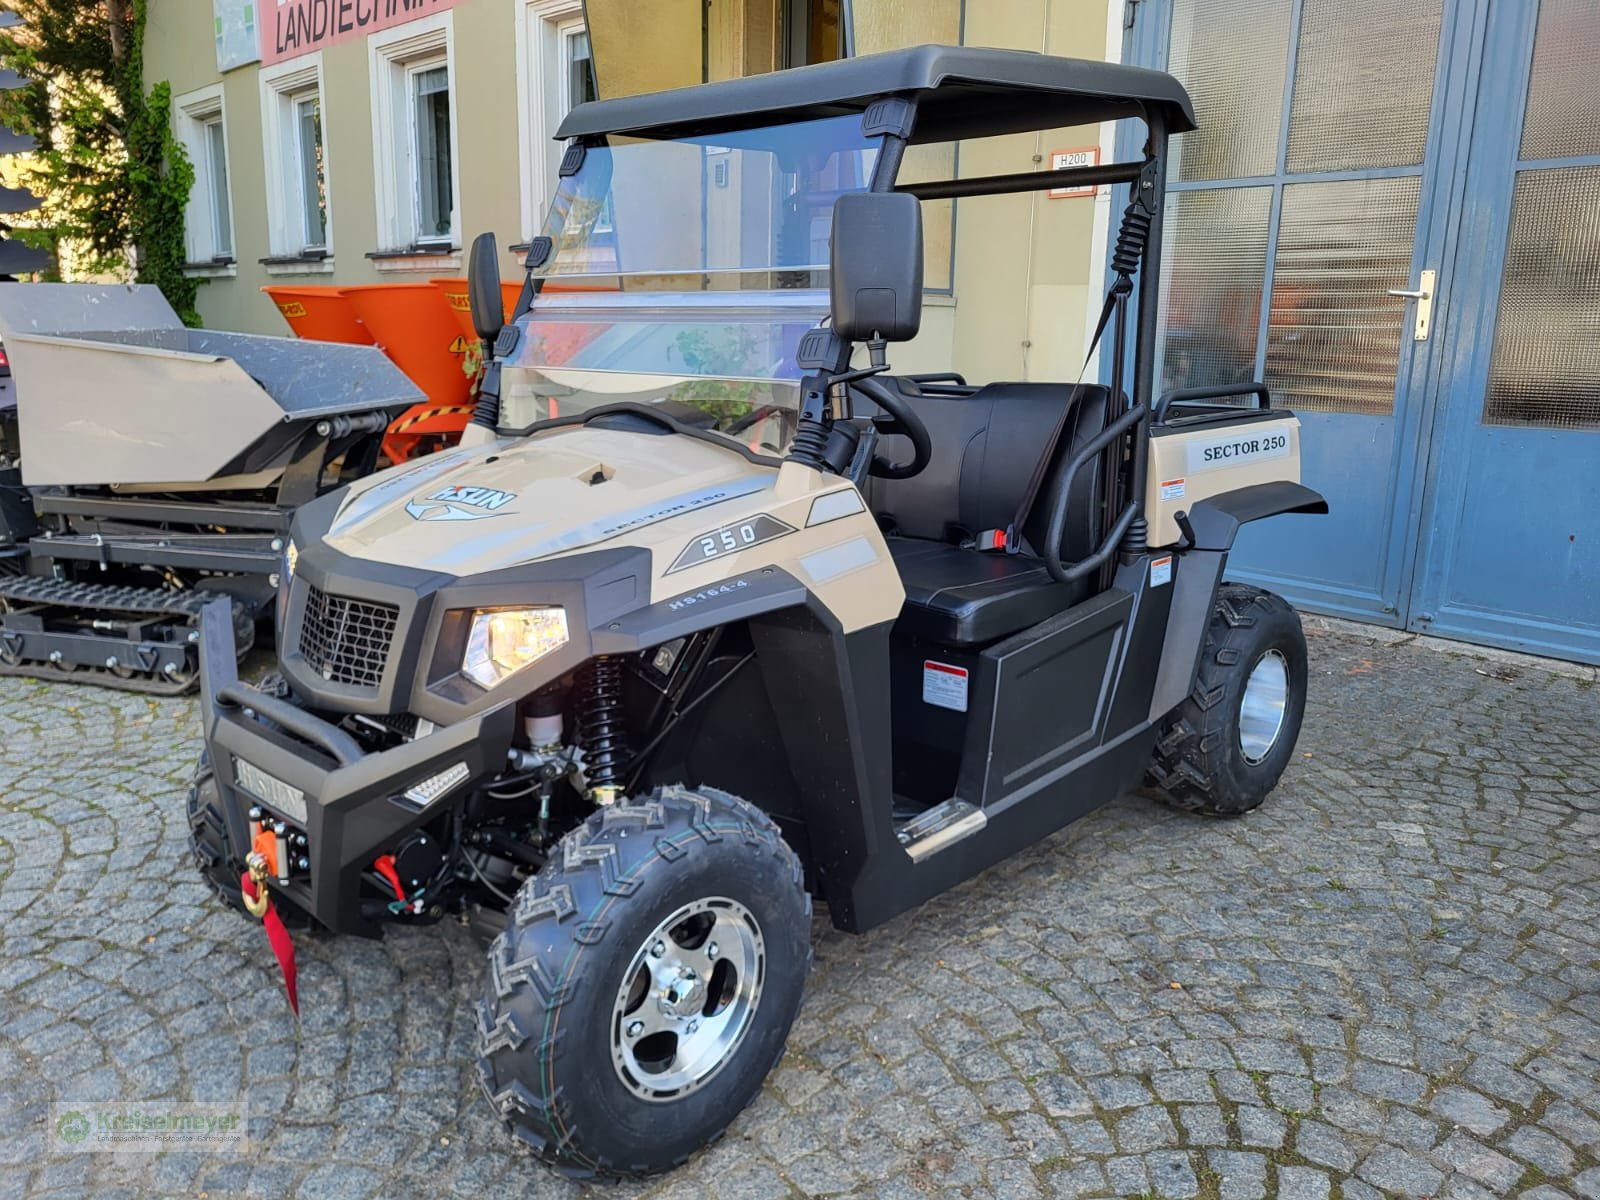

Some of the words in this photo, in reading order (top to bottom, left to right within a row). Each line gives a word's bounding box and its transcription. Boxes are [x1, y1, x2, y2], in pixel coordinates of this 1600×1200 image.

[276, 0, 438, 54] LANDTEC
[1203, 440, 1260, 462] SECTOR
[1262, 435, 1286, 451] 250
[603, 504, 686, 534] SECTOR
[690, 492, 726, 505] 250
[700, 525, 756, 558] 250
[668, 579, 748, 613] HS164-4
